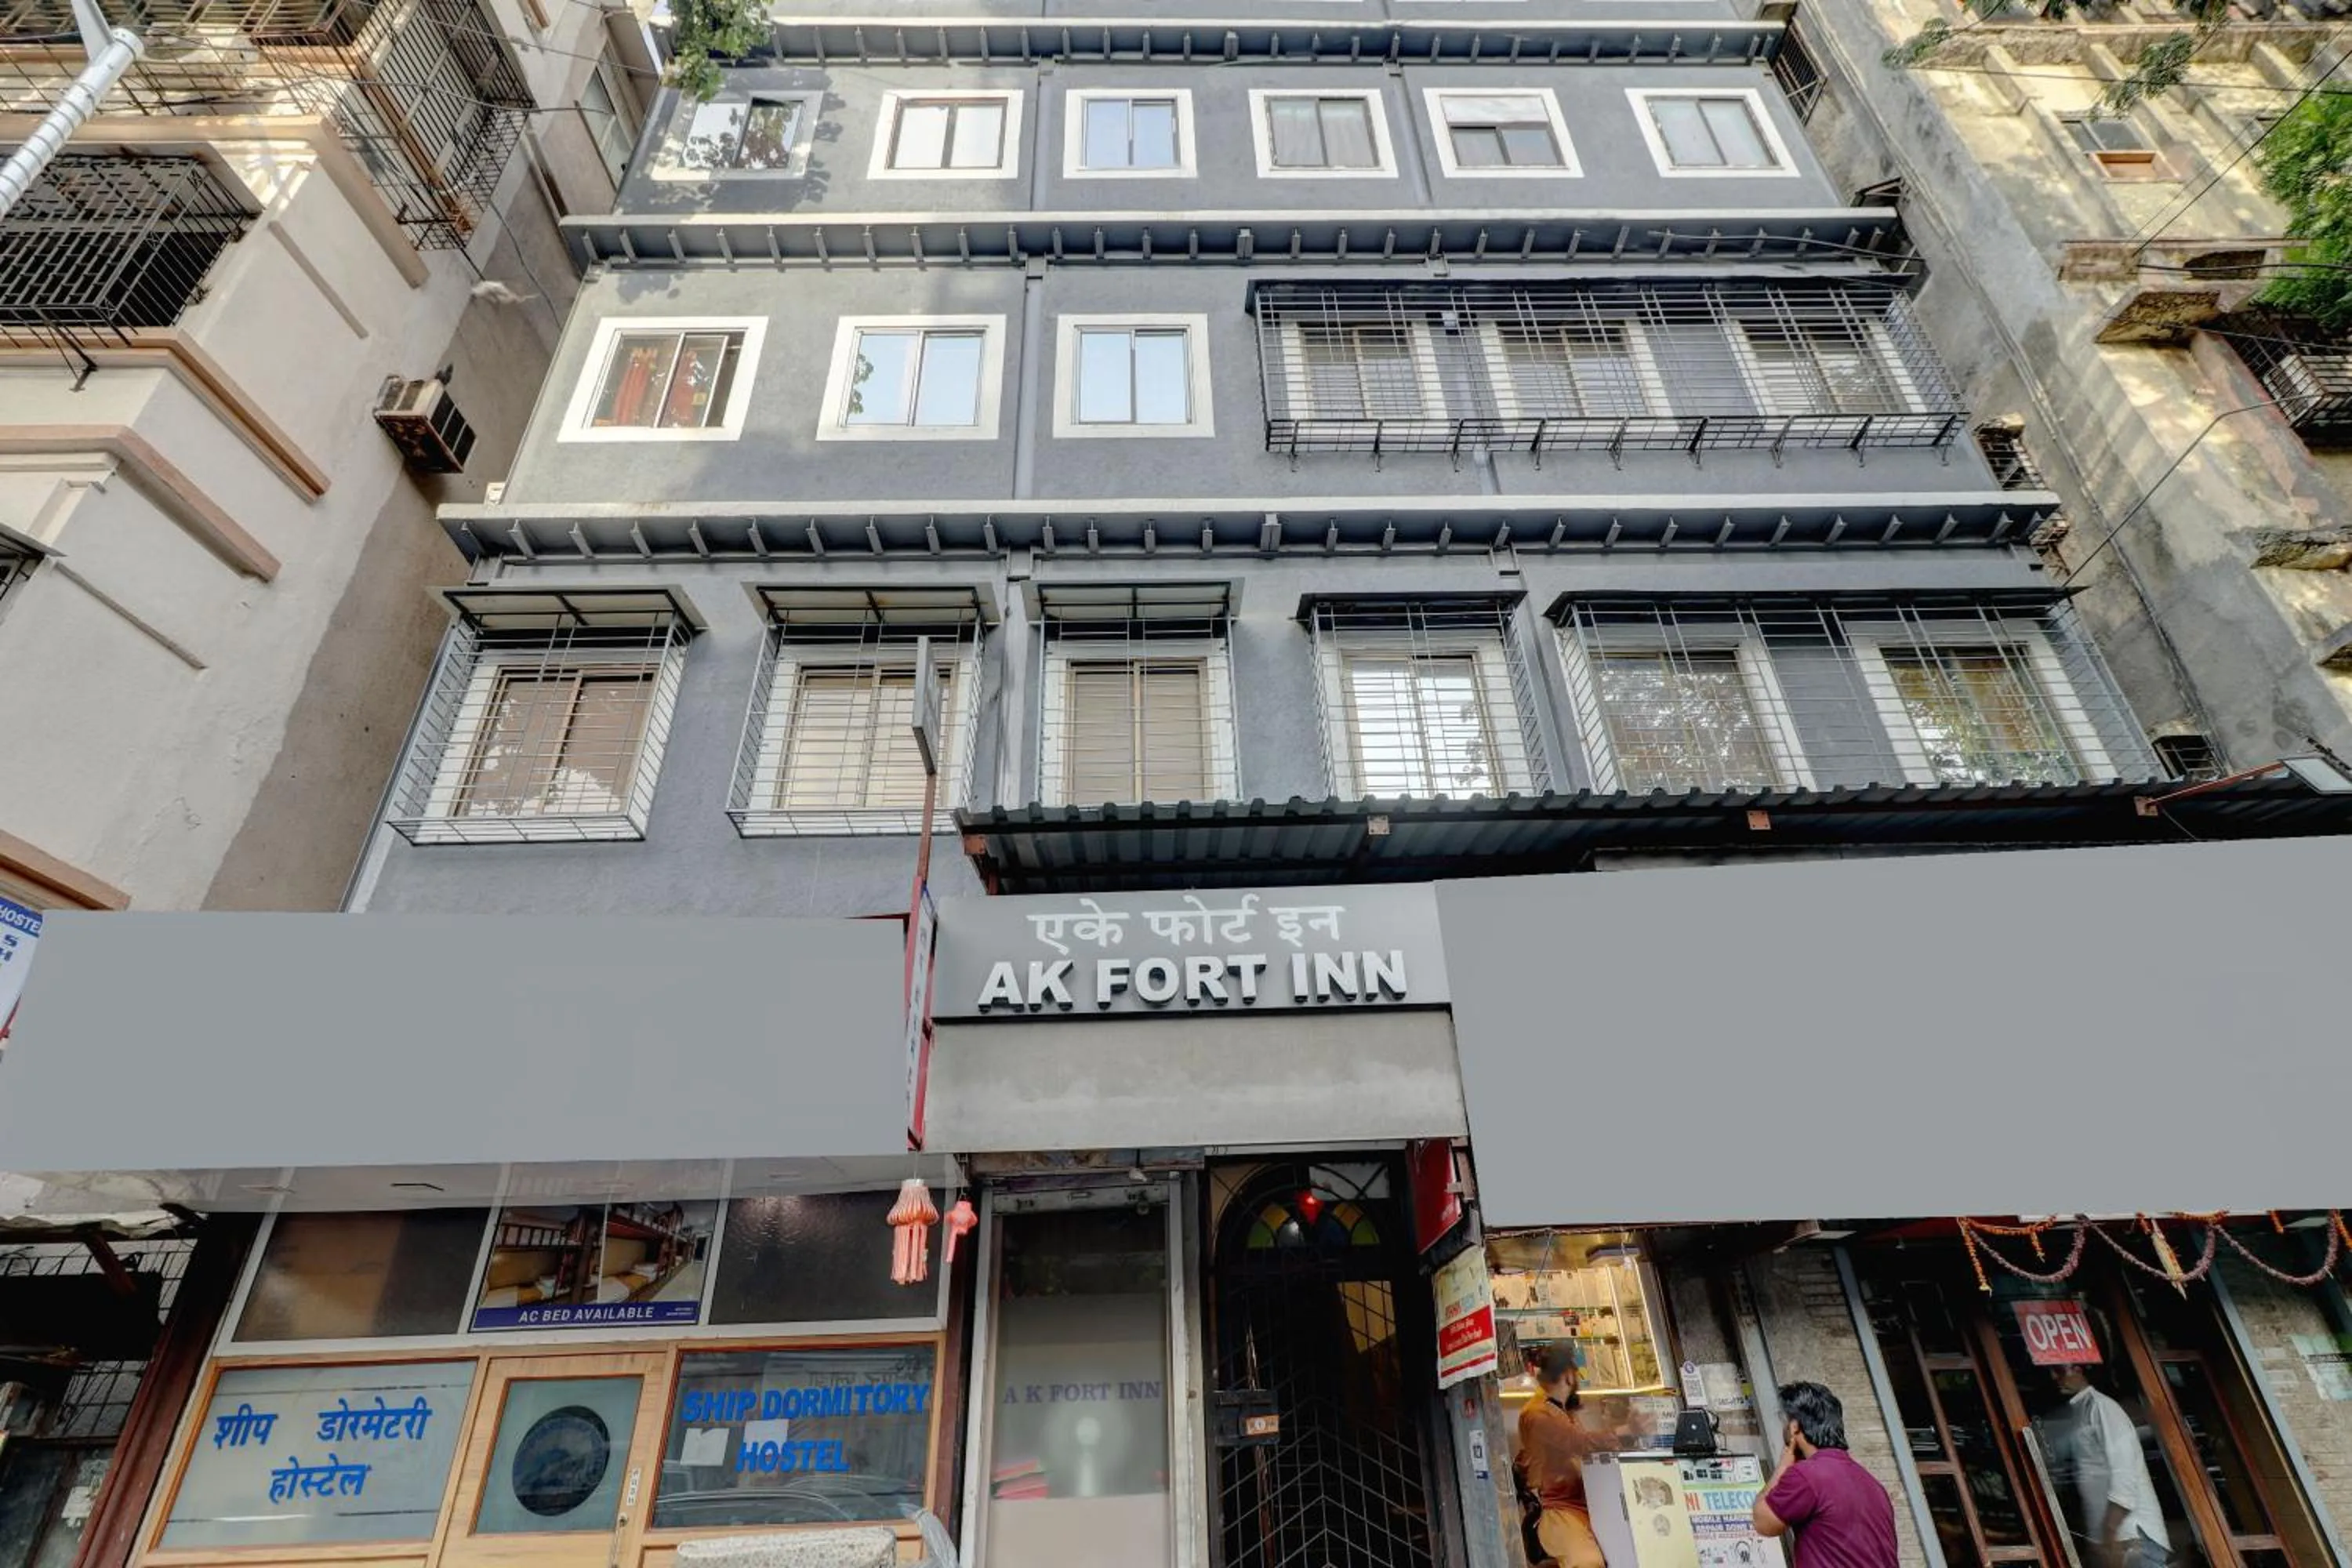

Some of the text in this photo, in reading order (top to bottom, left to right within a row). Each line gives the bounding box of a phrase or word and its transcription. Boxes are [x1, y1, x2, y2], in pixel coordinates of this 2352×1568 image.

[1027, 893, 1345, 955] एके फोर्ट इन
[978, 950, 1407, 1013] AK FORT INN
[518, 1310, 539, 1323] AC
[543, 1309, 571, 1323] BED
[574, 1306, 654, 1321] AVAILABLE
[2025, 1313, 2092, 1351] OPEN
[680, 1381, 930, 1423] SHIP DORMITORY
[1048, 1381, 1110, 1403] FORT
[1118, 1381, 1162, 1400] INN
[213, 1396, 433, 1450] शीप डोरमेटरी
[735, 1436, 851, 1474] HOSTEL
[269, 1453, 372, 1504] होस्टेल
